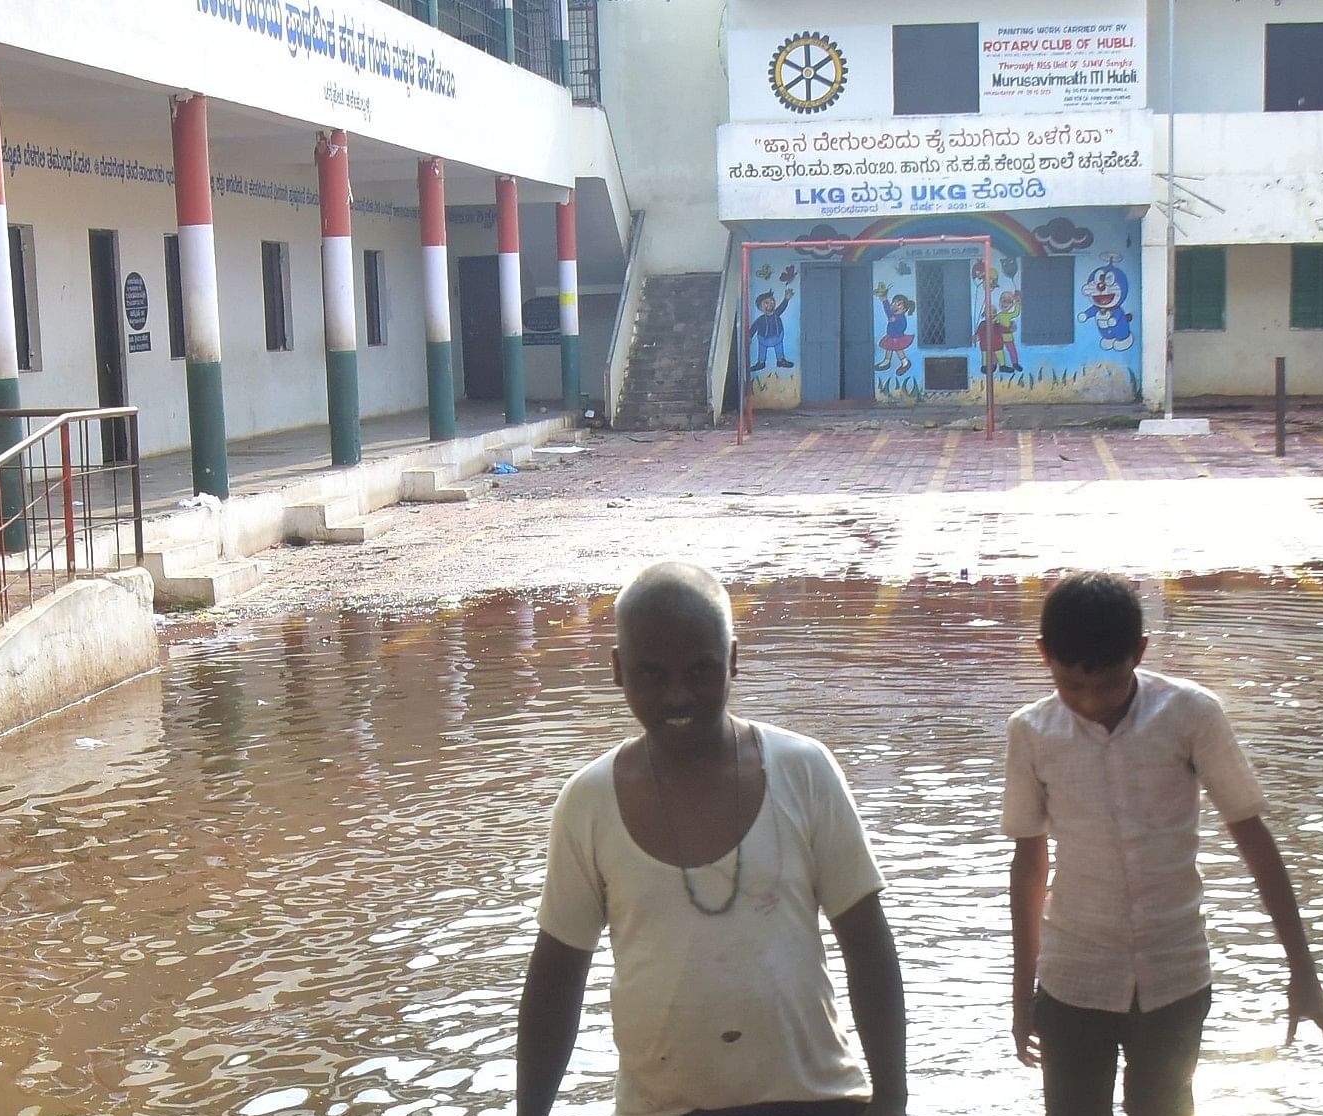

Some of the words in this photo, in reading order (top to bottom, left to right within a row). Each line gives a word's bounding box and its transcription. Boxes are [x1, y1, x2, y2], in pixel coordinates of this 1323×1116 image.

[982, 39, 1038, 52] ROTARY
[1041, 38, 1072, 50] CLUB
[1076, 38, 1091, 49] OF
[991, 70, 1086, 87] Murusavirmath
[1090, 71, 1103, 85] ITI
[813, 130, 920, 152] ದೇಗುಲವಿದು
[949, 127, 1020, 148] ಮುಗಿದು
[1028, 124, 1071, 145] ಒಳಗೆ
[1039, 151, 1074, 169] ಶಾಲೆ
[795, 187, 846, 205] LKG
[851, 181, 903, 209] ಮತ್ತು
[911, 184, 967, 201] UKG
[972, 177, 1046, 200] ಕೊಠಡಿ
